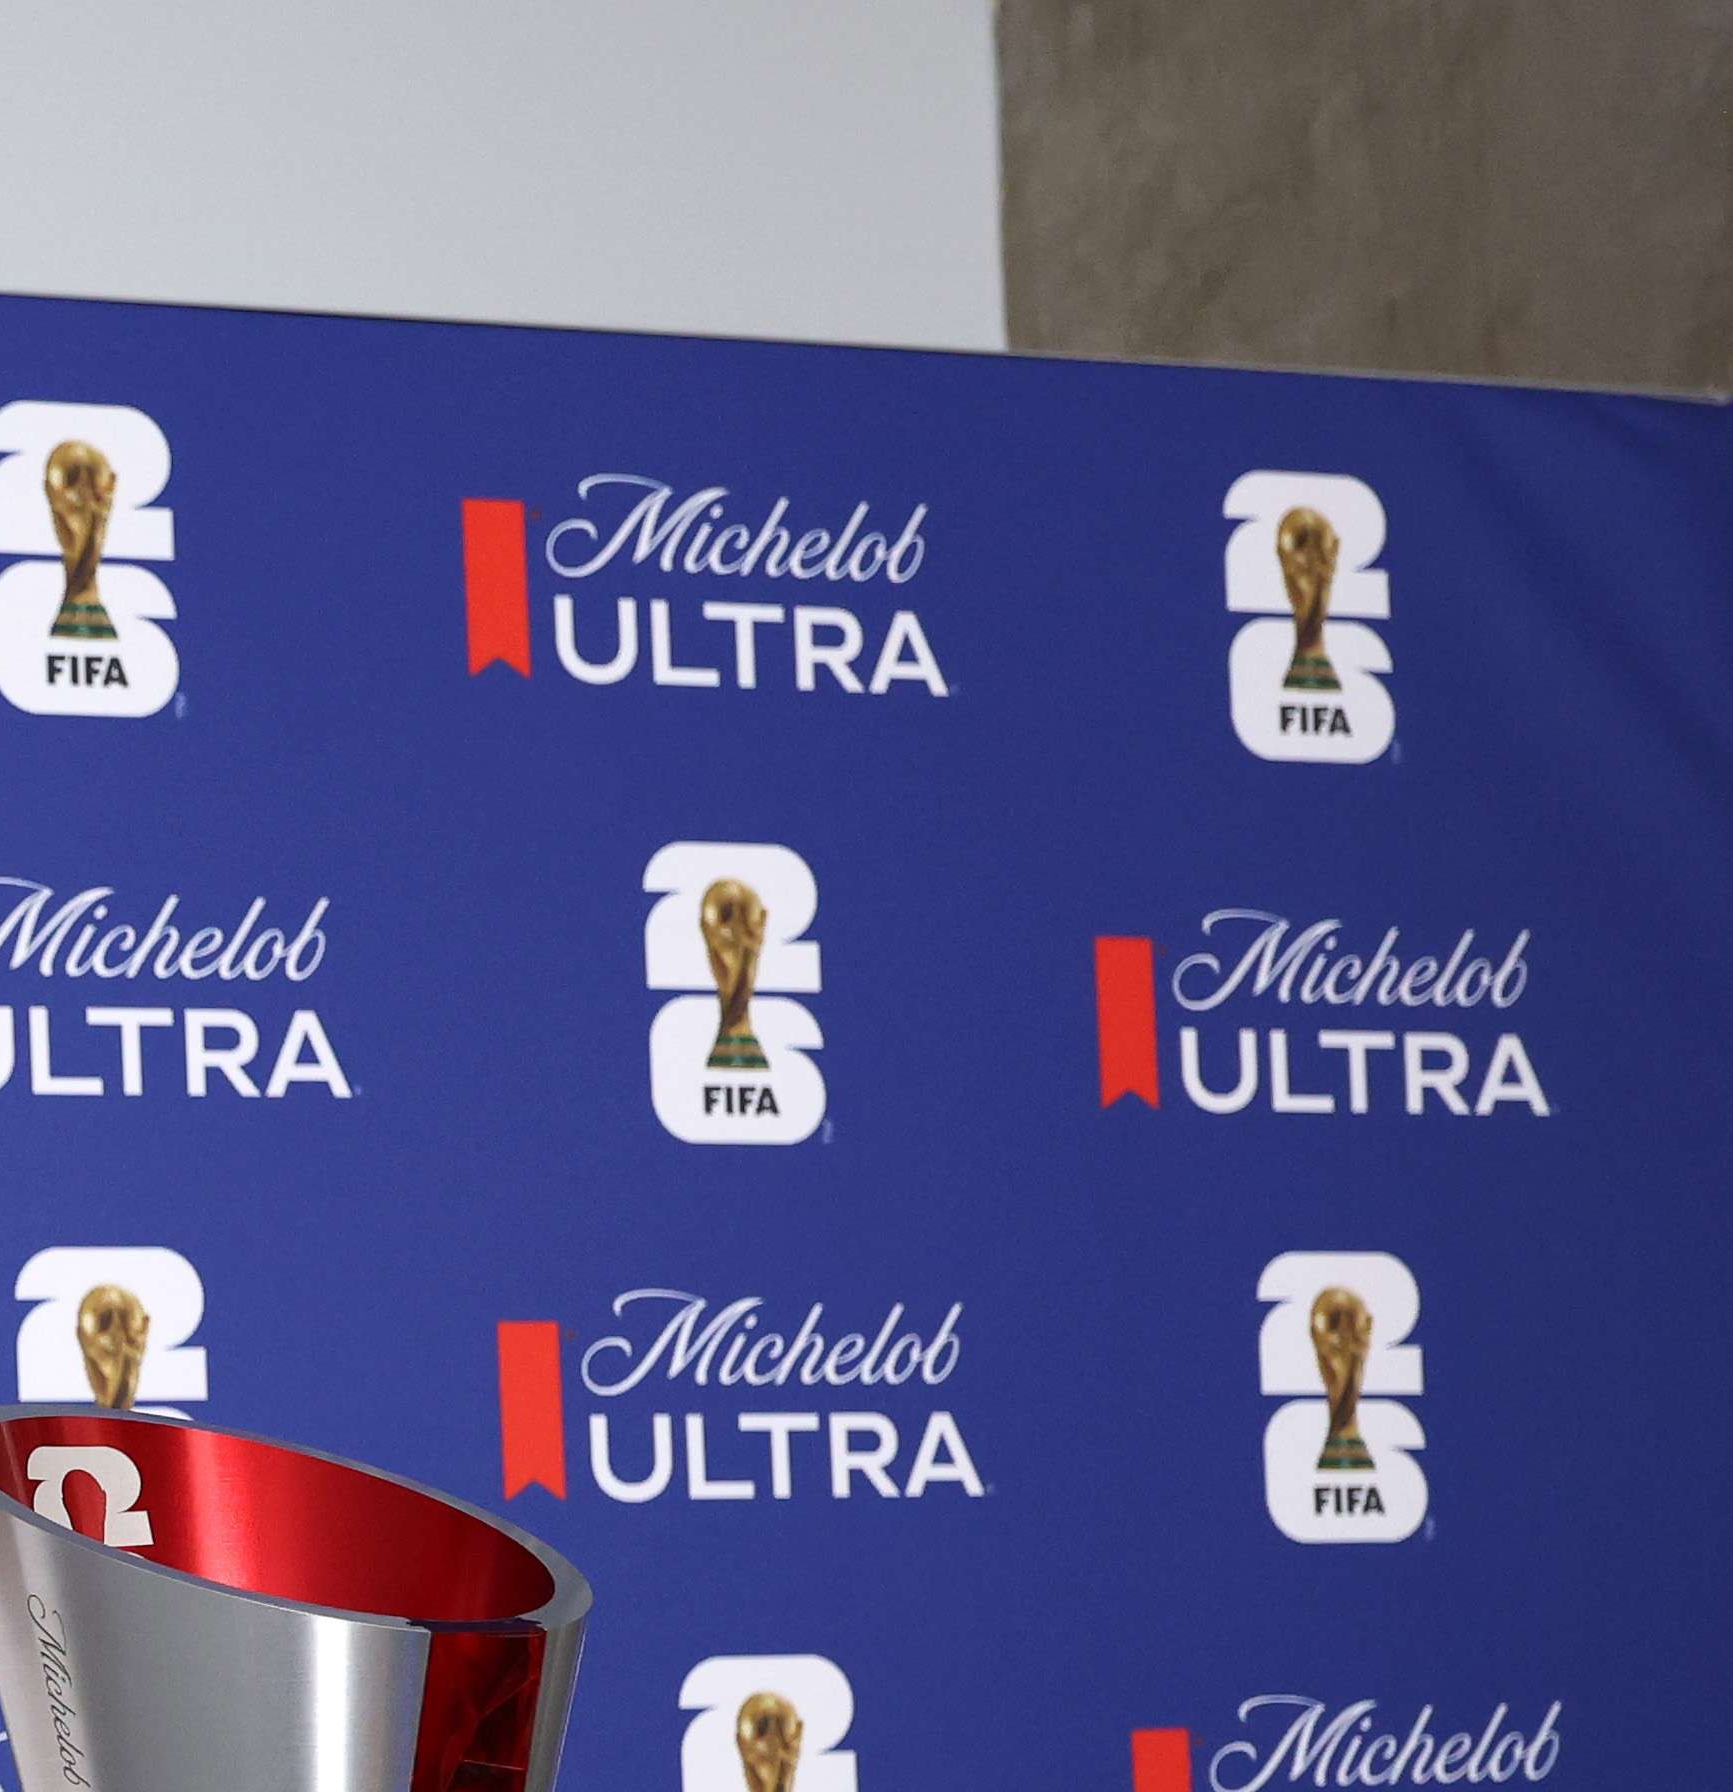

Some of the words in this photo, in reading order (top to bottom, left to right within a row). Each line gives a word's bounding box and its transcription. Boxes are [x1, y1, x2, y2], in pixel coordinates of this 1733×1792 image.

[546, 474, 927, 583] Michelob
[47, 654, 128, 688] FIFA
[554, 595, 948, 696] ULTRA
[1280, 705, 1351, 735] FIFA
[1173, 909, 1529, 1011] Michelob
[704, 1086, 780, 1116] FIFA
[1180, 1027, 1549, 1116] ULTRA
[581, 1289, 962, 1396] Michelob
[589, 1412, 984, 1503] ULTRA
[1314, 1486, 1385, 1514] FIFA
[28, 1594, 91, 1788] Michelob
